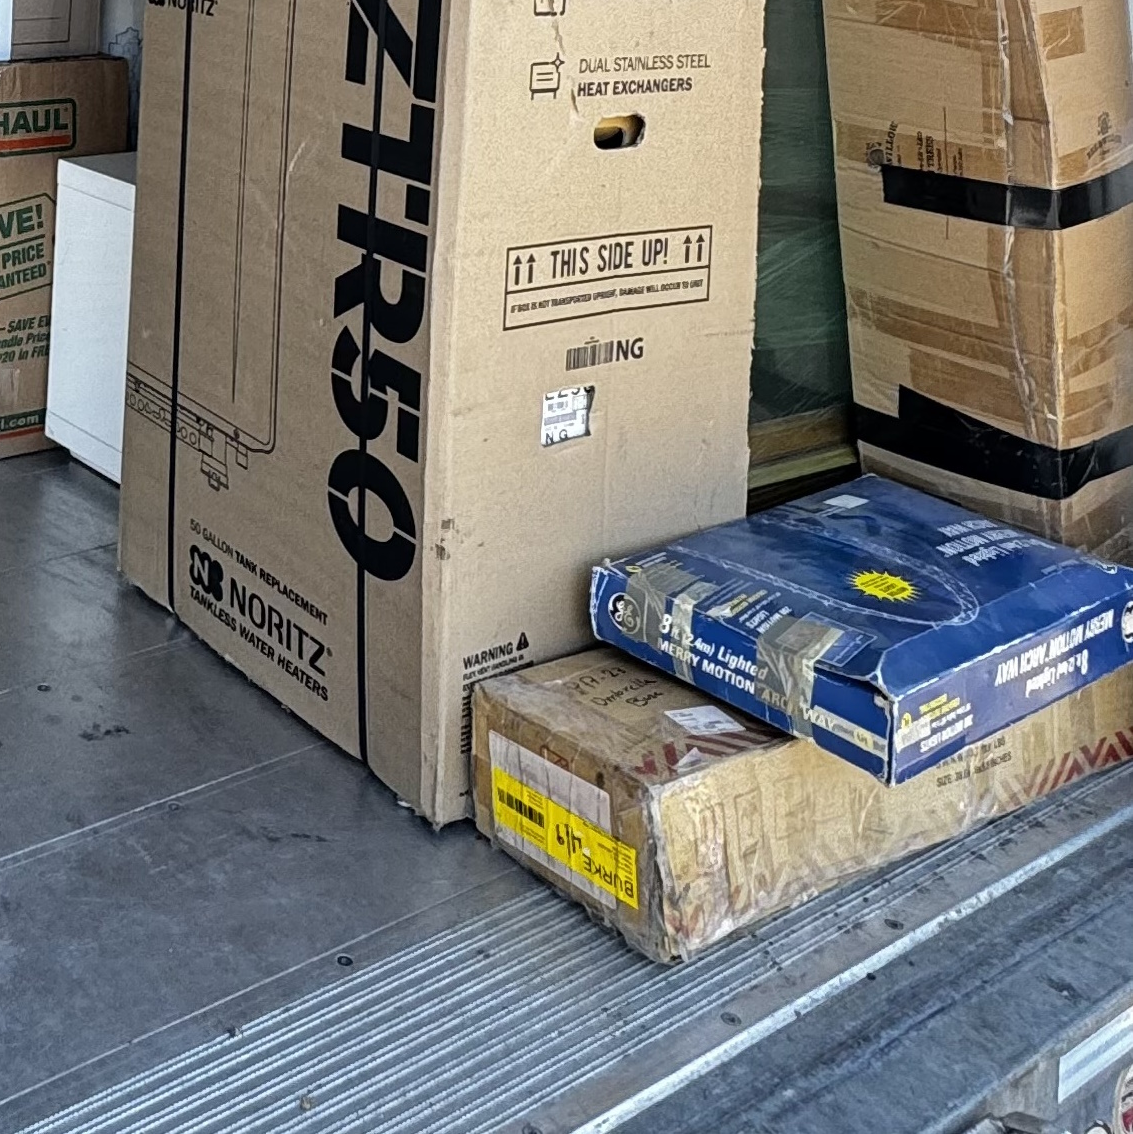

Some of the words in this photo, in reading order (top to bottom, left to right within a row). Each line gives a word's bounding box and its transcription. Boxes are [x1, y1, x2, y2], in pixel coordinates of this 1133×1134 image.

[579, 57, 611, 74] DUAL
[613, 55, 674, 73] STAINLESS
[676, 53, 711, 69] STEEL
[577, 81, 610, 97] HEAT
[612, 77, 693, 96] EXCHANGERS
[1, 242, 45, 270] PRICE
[551, 246, 590, 279] THIS
[597, 240, 634, 273] SIDE
[641, 237, 669, 267] UP!
[31, 345, 50, 358] FRE
[615, 337, 644, 362] NG
[189, 518, 201, 536] 50
[202, 525, 234, 559] GALLON
[234, 550, 258, 577] TANK
[259, 568, 329, 626] REPLACEMENT
[189, 584, 237, 633] TANKLESS
[238, 626, 276, 662] WATER
[277, 653, 329, 702] HEATERS
[229, 576, 327, 677] NORITZ
[658, 613, 672, 634] 8
[717, 645, 768, 680] Lighted
[463, 641, 514, 670] WARNING
[657, 637, 700, 667] MERRY
[701, 658, 756, 695] MOTION
[582, 855, 634, 899] BURKE
